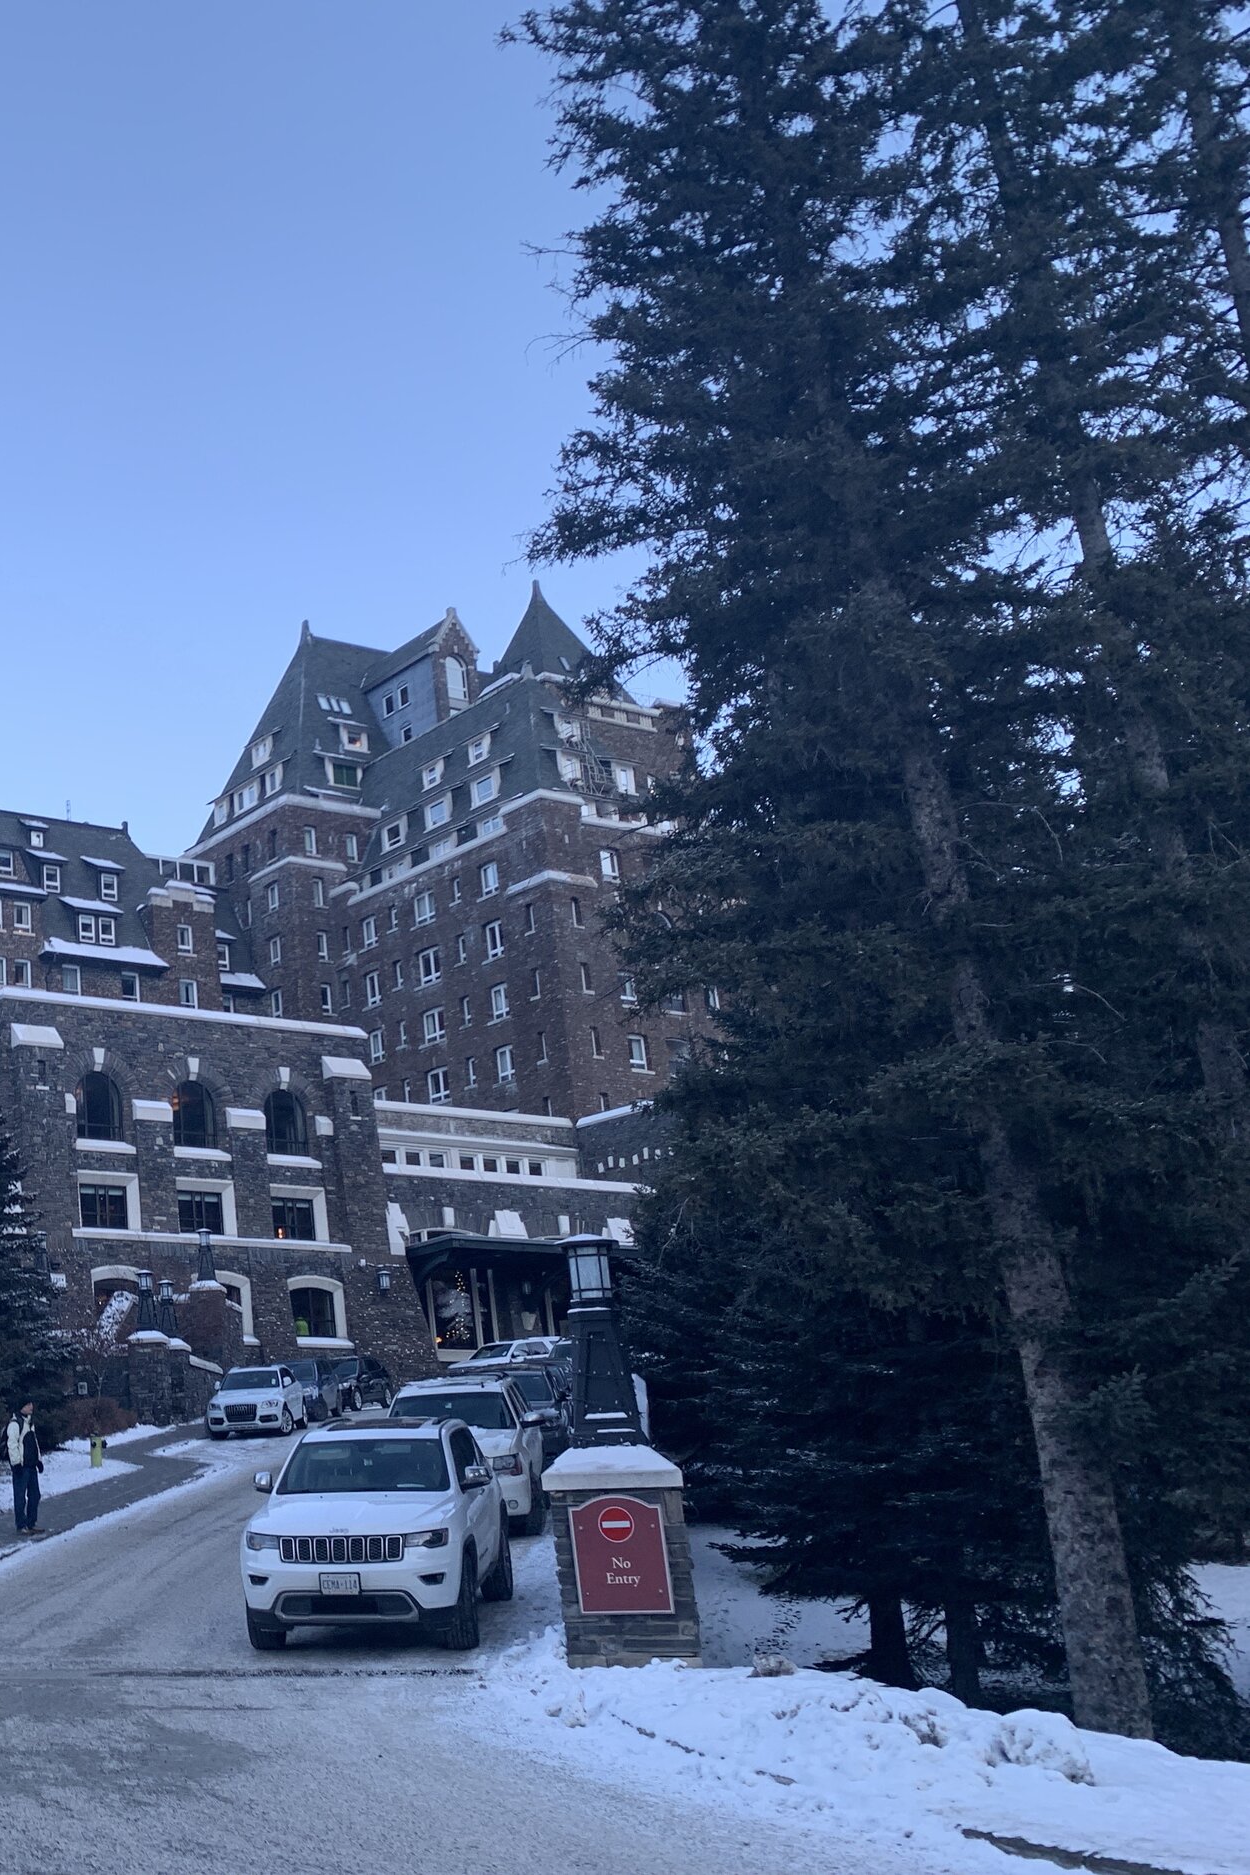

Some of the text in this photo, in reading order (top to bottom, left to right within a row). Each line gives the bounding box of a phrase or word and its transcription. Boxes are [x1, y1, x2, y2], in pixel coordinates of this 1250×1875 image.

[328, 1526, 350, 1534] Jeep
[611, 1556, 632, 1569] No
[606, 1572, 641, 1587] Entry
